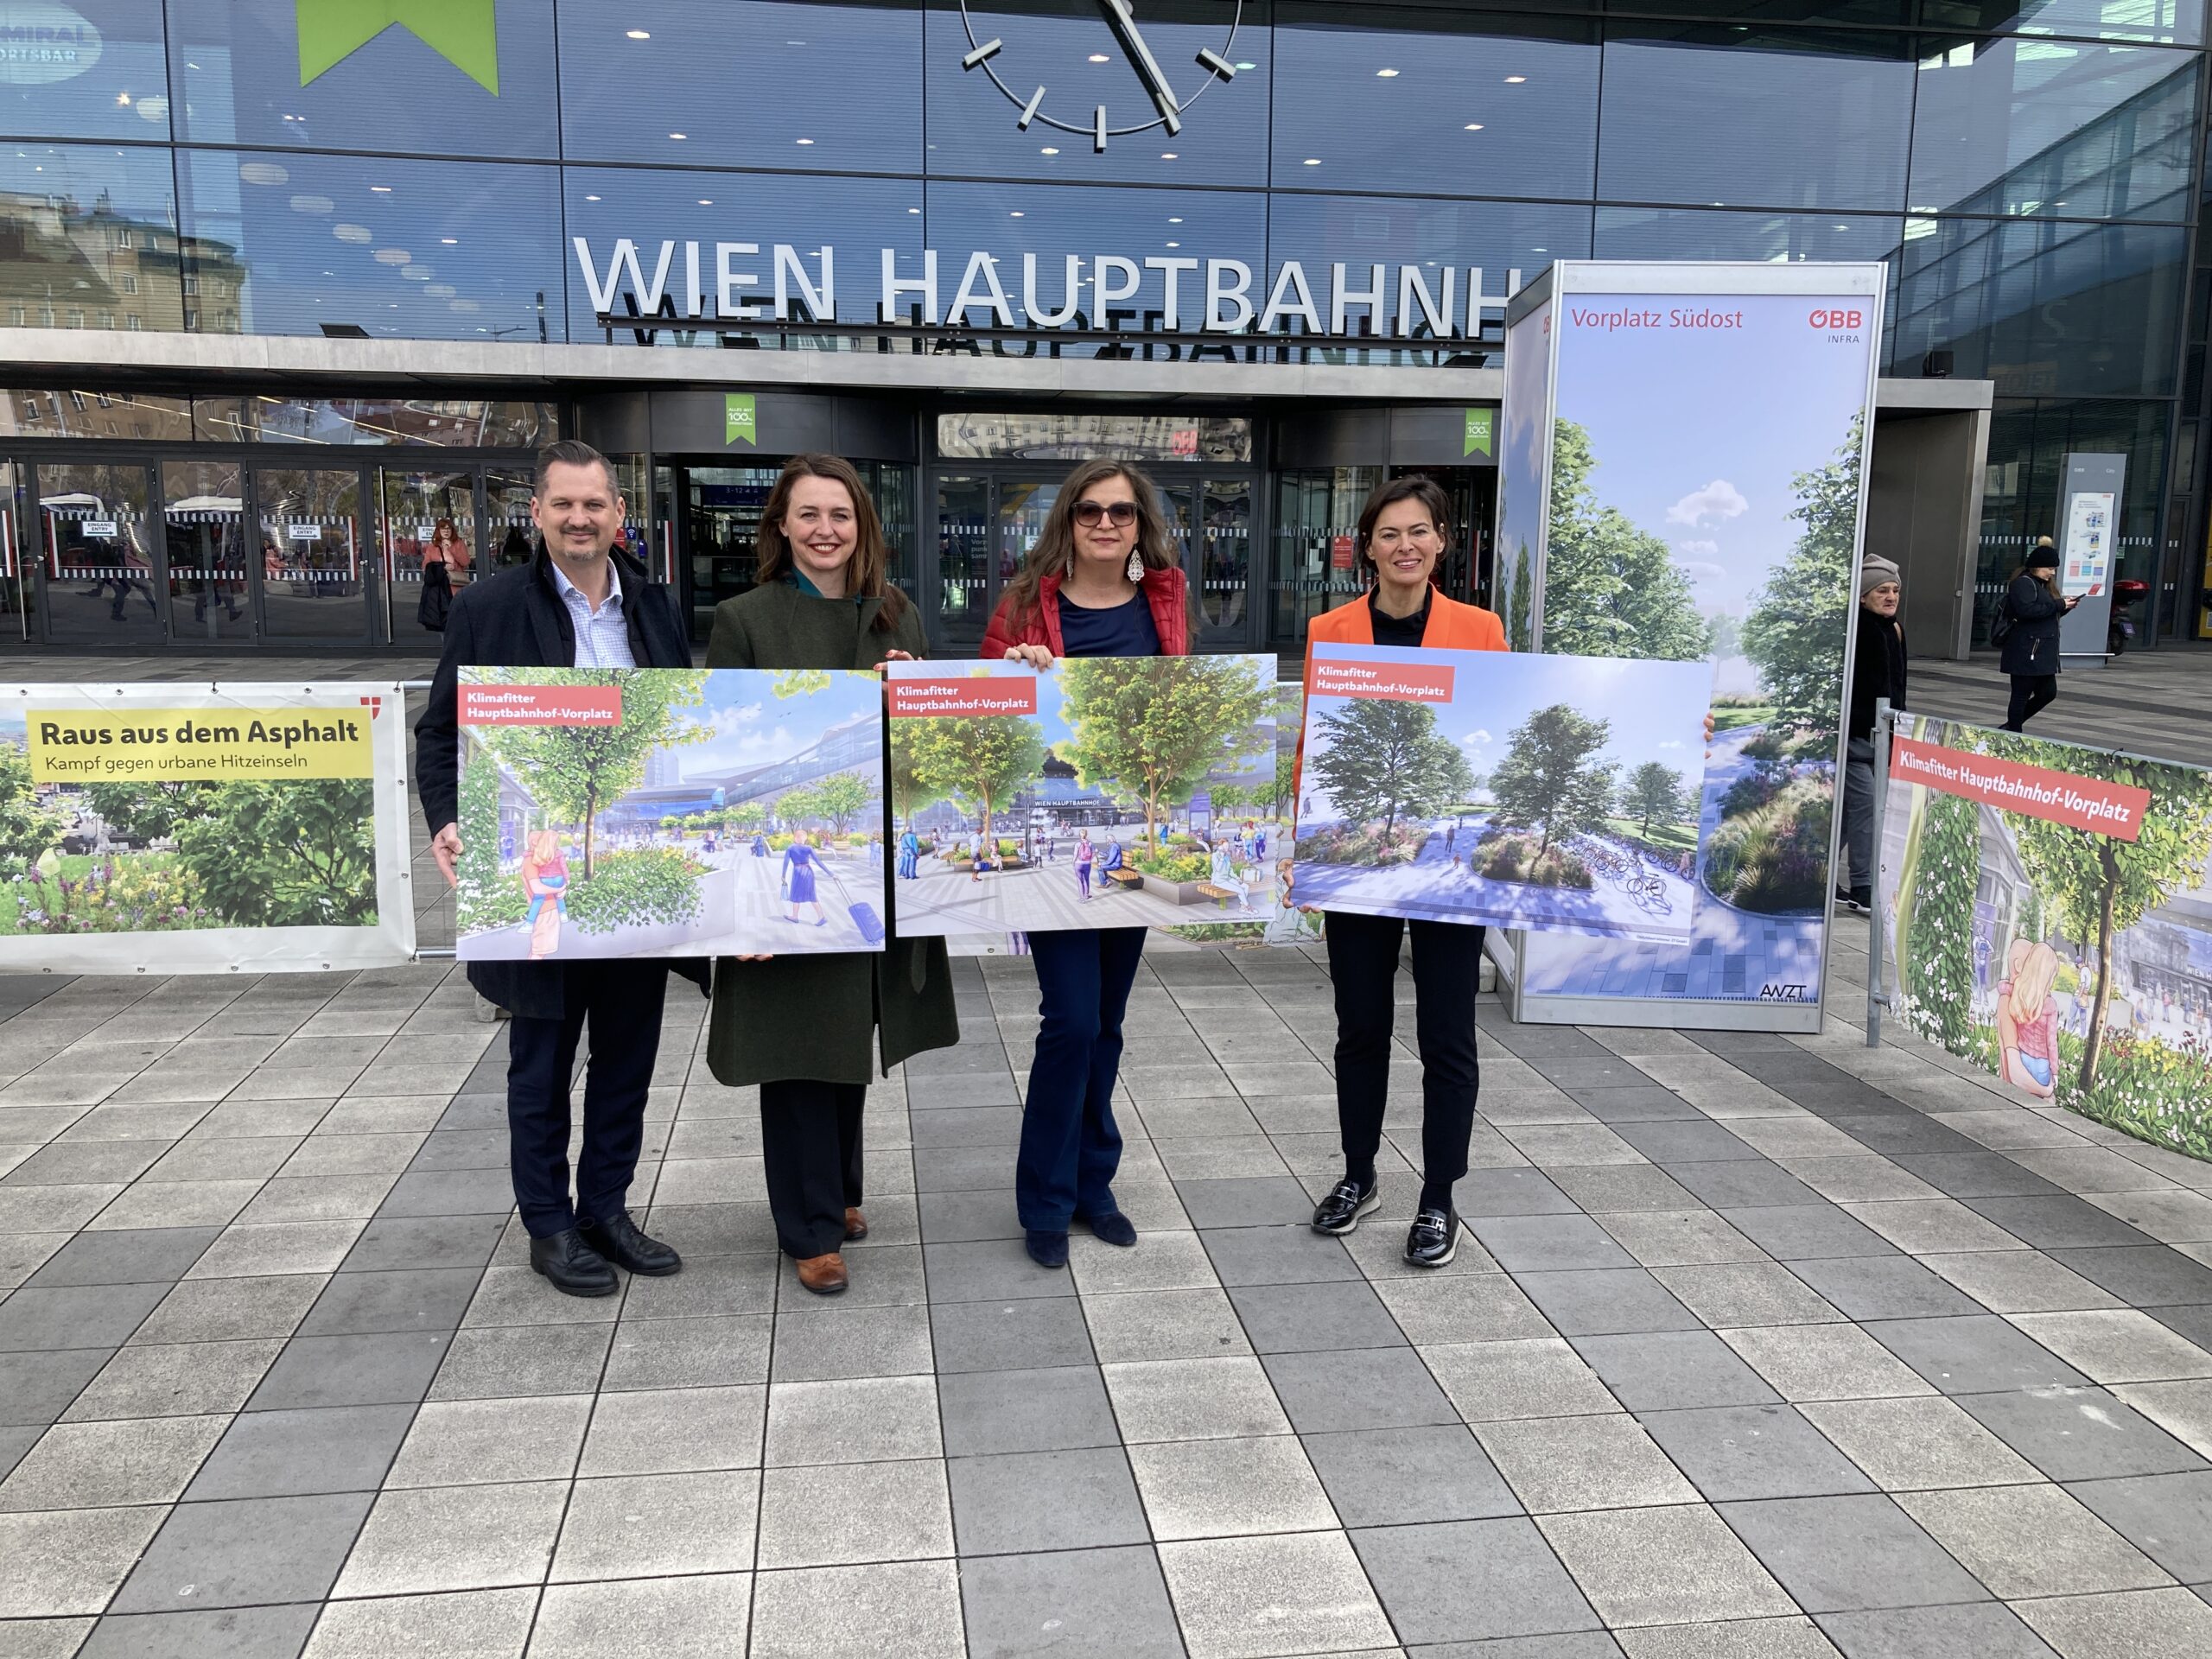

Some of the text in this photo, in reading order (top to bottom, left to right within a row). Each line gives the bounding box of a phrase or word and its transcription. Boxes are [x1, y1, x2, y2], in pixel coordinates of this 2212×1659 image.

[572, 237, 1522, 338] WIEN HAUPTBAHNH
[1571, 308, 1744, 332] Vorplatz Südost
[1808, 309, 1862, 329] ÖBB
[1827, 334, 1860, 345] INFRA
[1318, 665, 1377, 679] Klimafitter
[896, 685, 959, 696] Klimafitter
[1316, 679, 1446, 697] Hauptbahnhof-Vorplatz
[467, 692, 536, 703] Klimafitter
[897, 698, 1029, 713] Hauptbahnhof-Vorplatz
[467, 707, 613, 721] Hauptbahnhof-Vorplatz
[41, 719, 359, 749] Raus aus dem Asphalt
[46, 753, 308, 773] Kampf gegen urbane Hitzeinseln
[1900, 749, 2131, 823] Klimafitter Hauptbahnhof-Vorplatz
